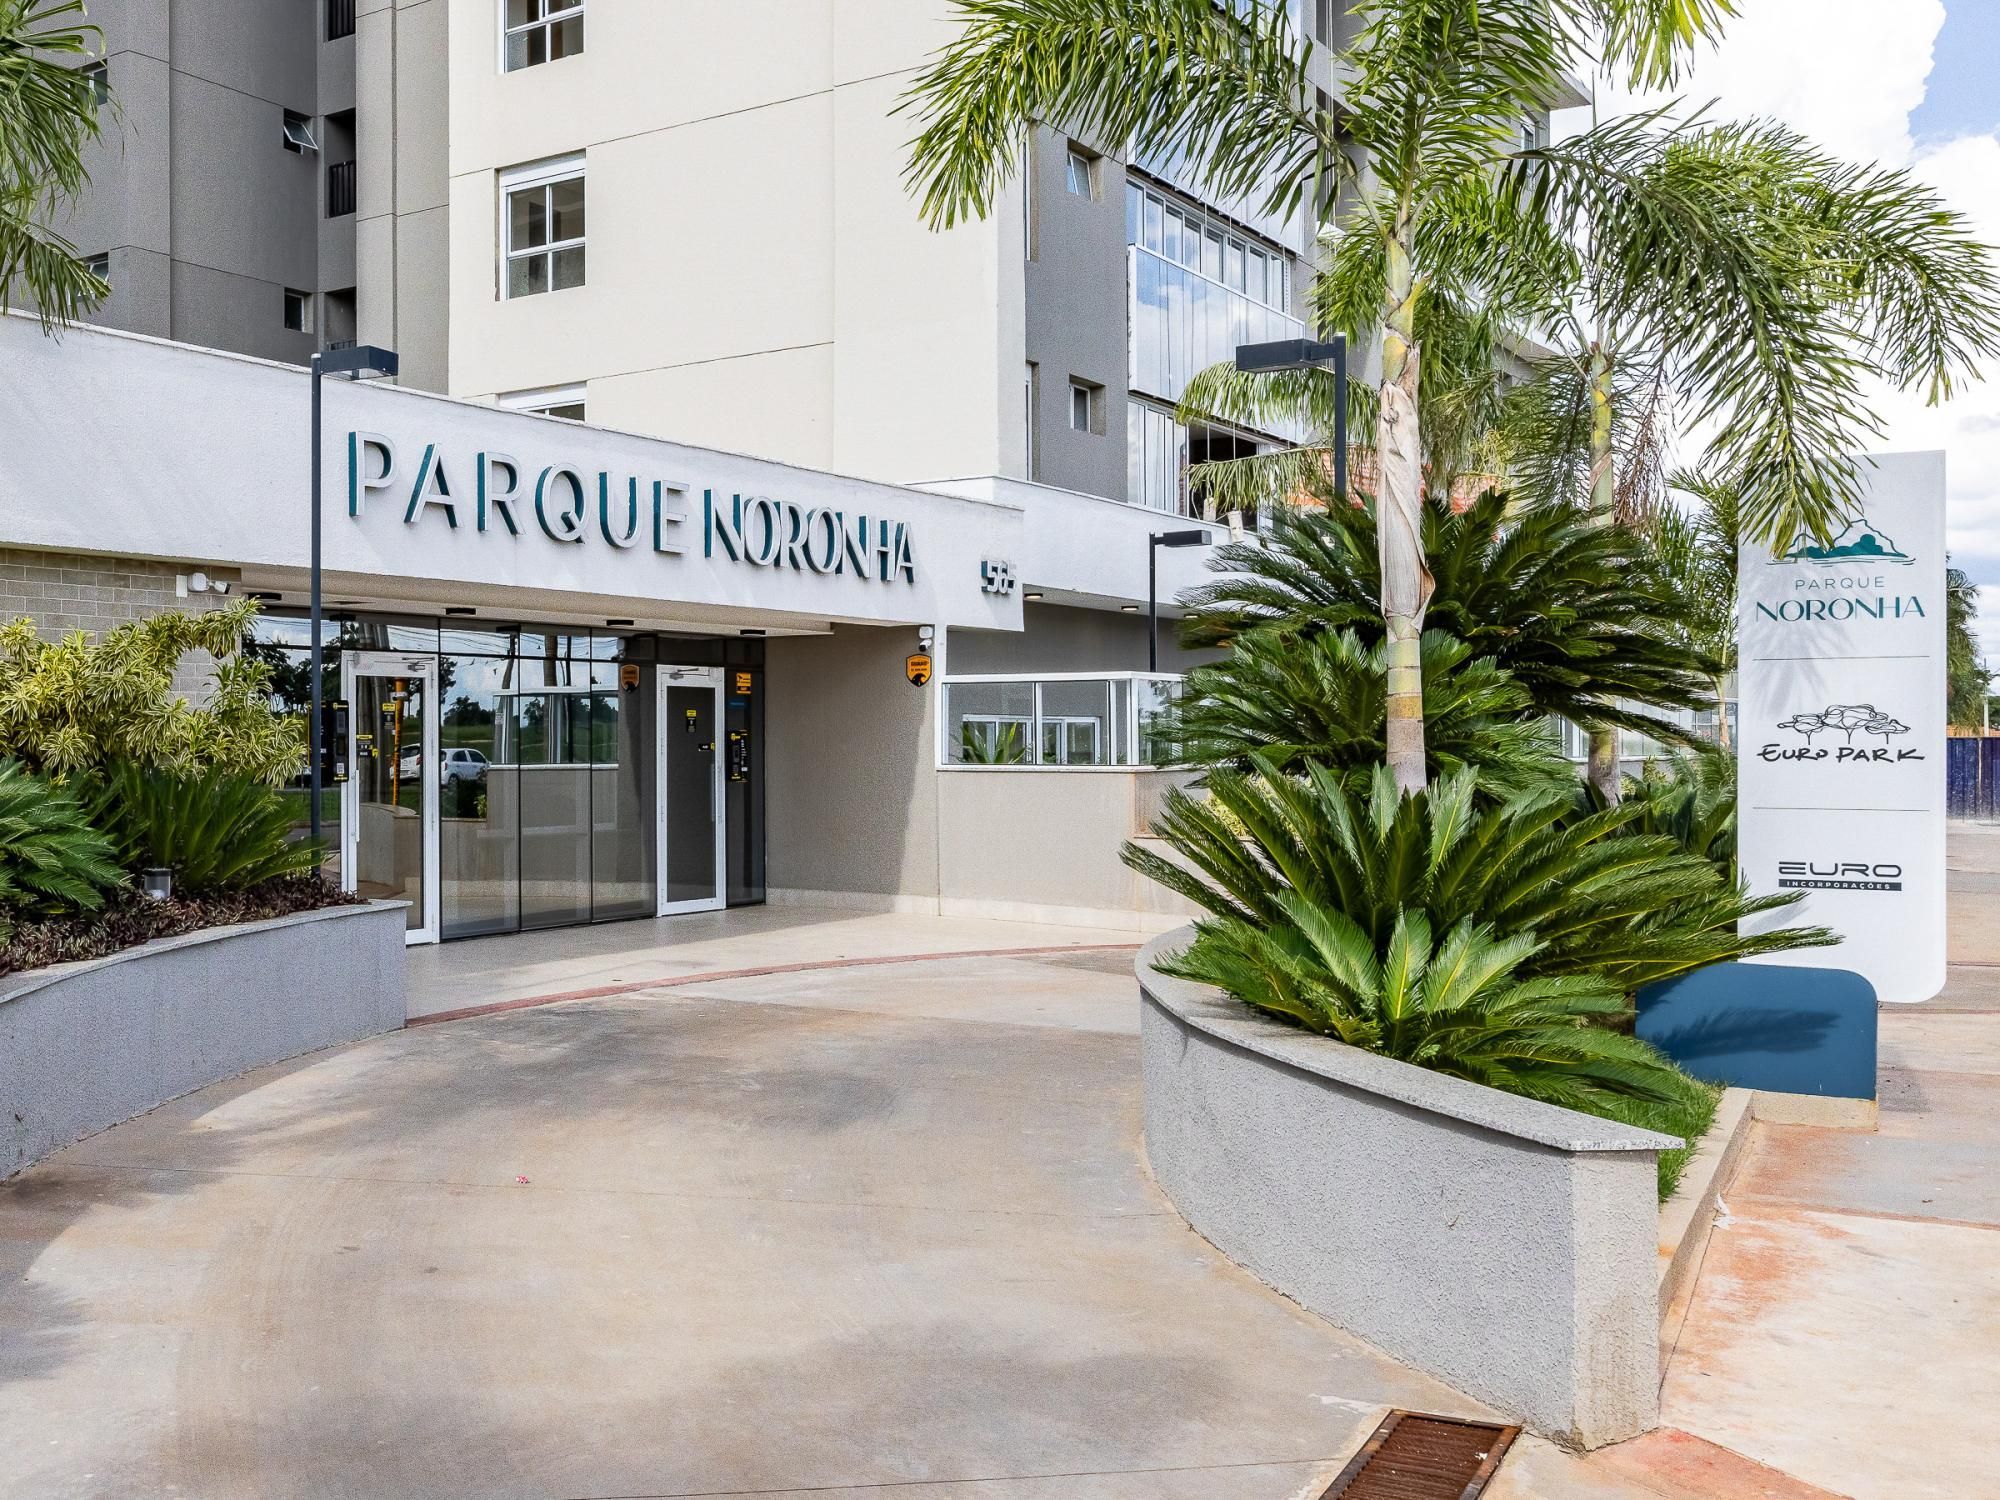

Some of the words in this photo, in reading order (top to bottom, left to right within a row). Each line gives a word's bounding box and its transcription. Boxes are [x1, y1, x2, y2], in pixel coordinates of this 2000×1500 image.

[349, 431, 690, 553] PARQUE
[704, 488, 915, 583] NORONHA
[1795, 576, 1885, 591] PARQUE
[1755, 596, 1926, 622] NORONHA
[1836, 747, 1925, 763] PARK
[1778, 861, 1902, 878] EURO
[1786, 880, 1891, 890] INCORPORAÇÕES
